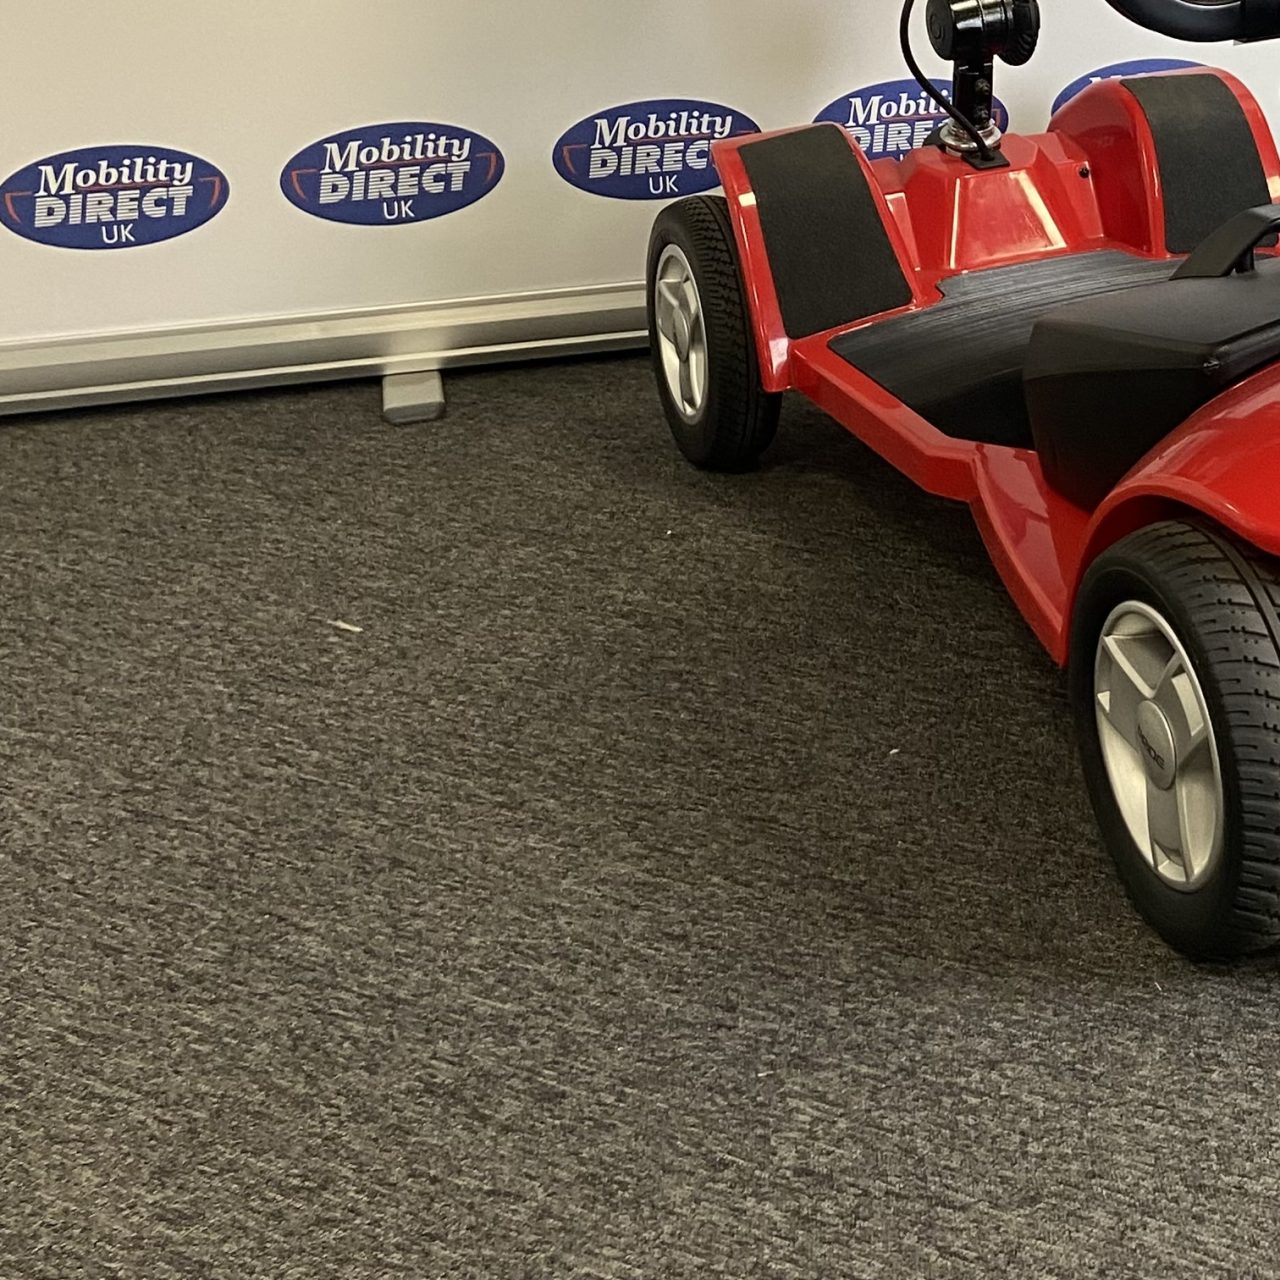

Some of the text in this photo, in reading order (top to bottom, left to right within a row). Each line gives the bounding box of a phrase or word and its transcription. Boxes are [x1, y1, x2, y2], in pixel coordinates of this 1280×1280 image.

[844, 89, 952, 127] Mobil
[590, 110, 733, 149] Mobility
[848, 119, 936, 152] DIRE
[320, 133, 471, 174] Mobility
[588, 140, 709, 179] DIREC
[34, 156, 193, 197] Mobility
[319, 161, 471, 204] DIRECT
[649, 174, 680, 194] UK
[34, 185, 194, 228] DIRECT
[383, 199, 415, 219] UK
[102, 223, 136, 243] UK
